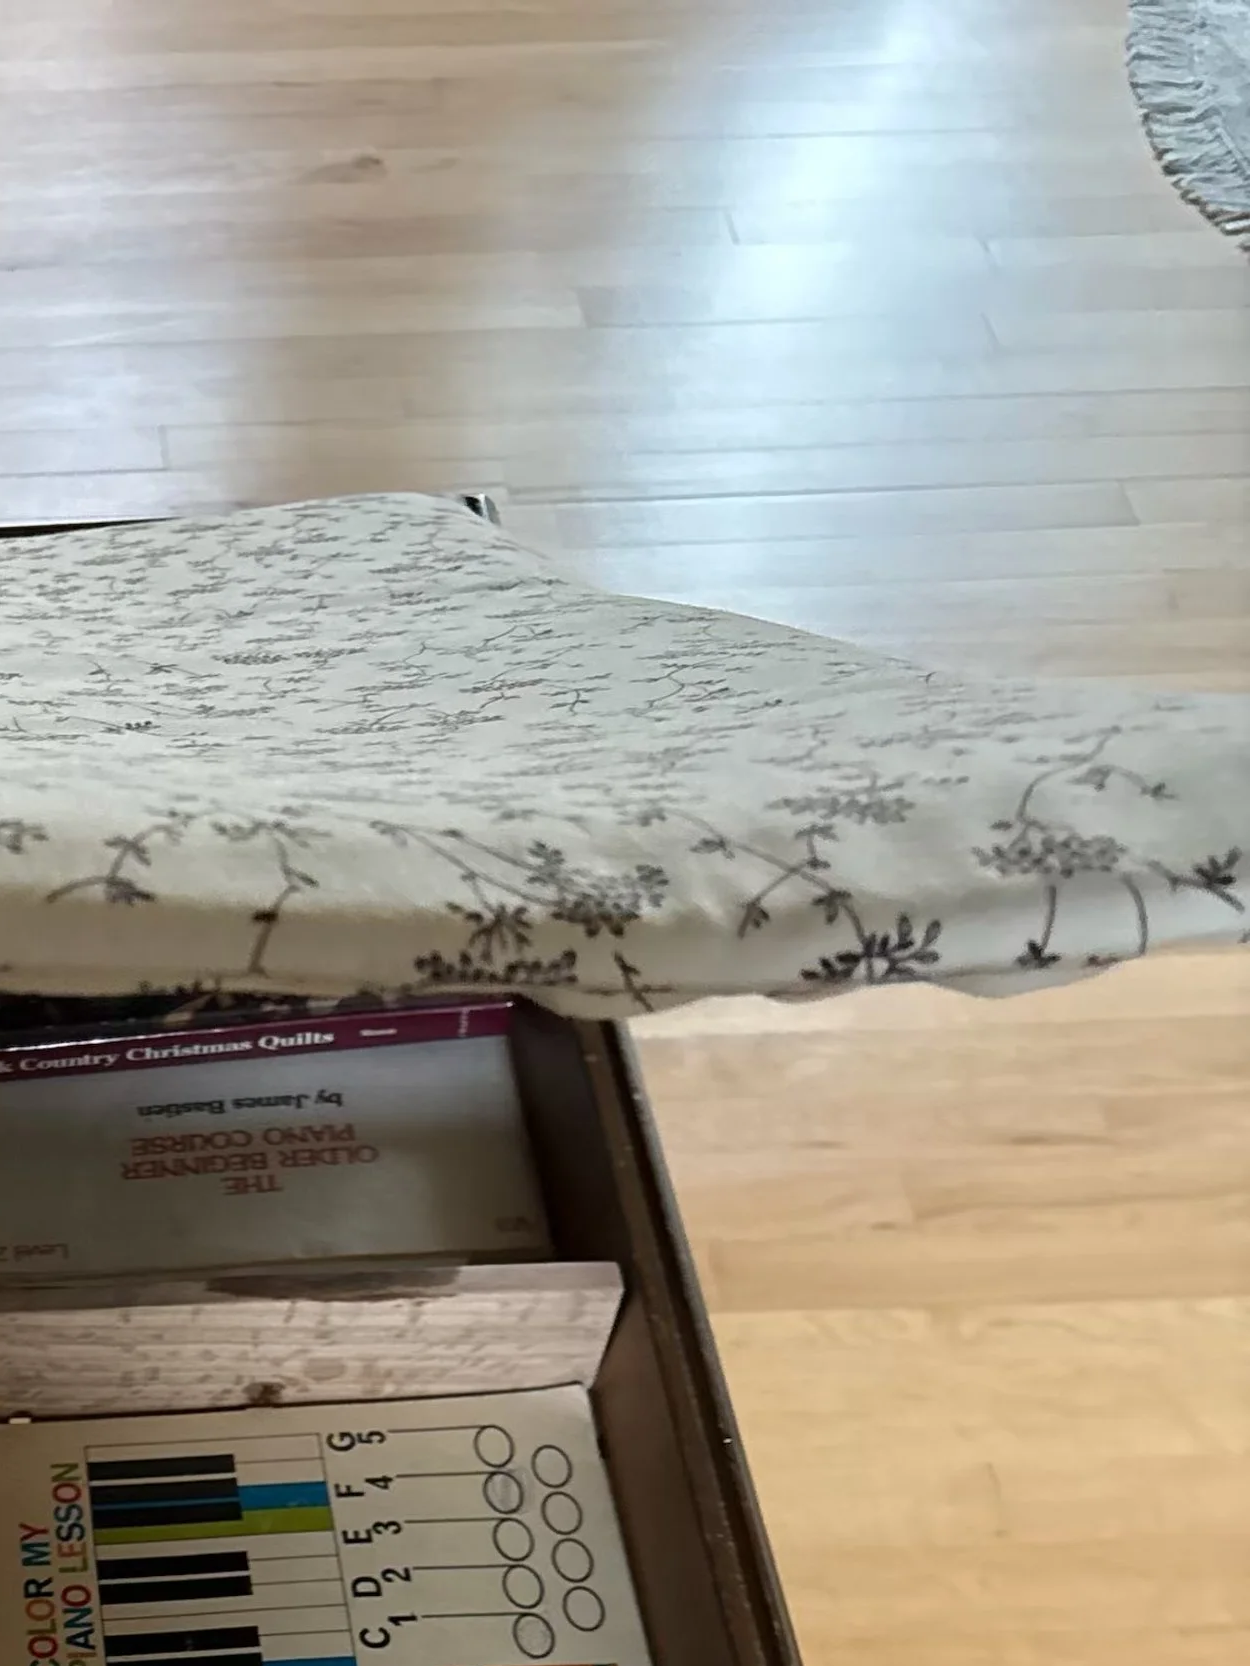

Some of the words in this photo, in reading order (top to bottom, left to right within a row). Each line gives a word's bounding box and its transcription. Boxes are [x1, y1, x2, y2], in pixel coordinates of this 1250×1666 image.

[20, 1048, 119, 1072] Country
[126, 1037, 253, 1062] Christmas
[257, 1030, 336, 1050] Quilts
[137, 1099, 226, 1119] Bastien
[232, 1096, 310, 1109] James
[315, 1089, 344, 1107] by
[130, 1130, 253, 1157] COURSE
[263, 1123, 356, 1146] PIANO
[120, 1151, 269, 1181] BEGINNER
[279, 1144, 380, 1169] OLDER
[221, 1175, 283, 1196] THE
[50, 1462, 88, 1573] LESSON
[18, 1522, 52, 1567] MY
